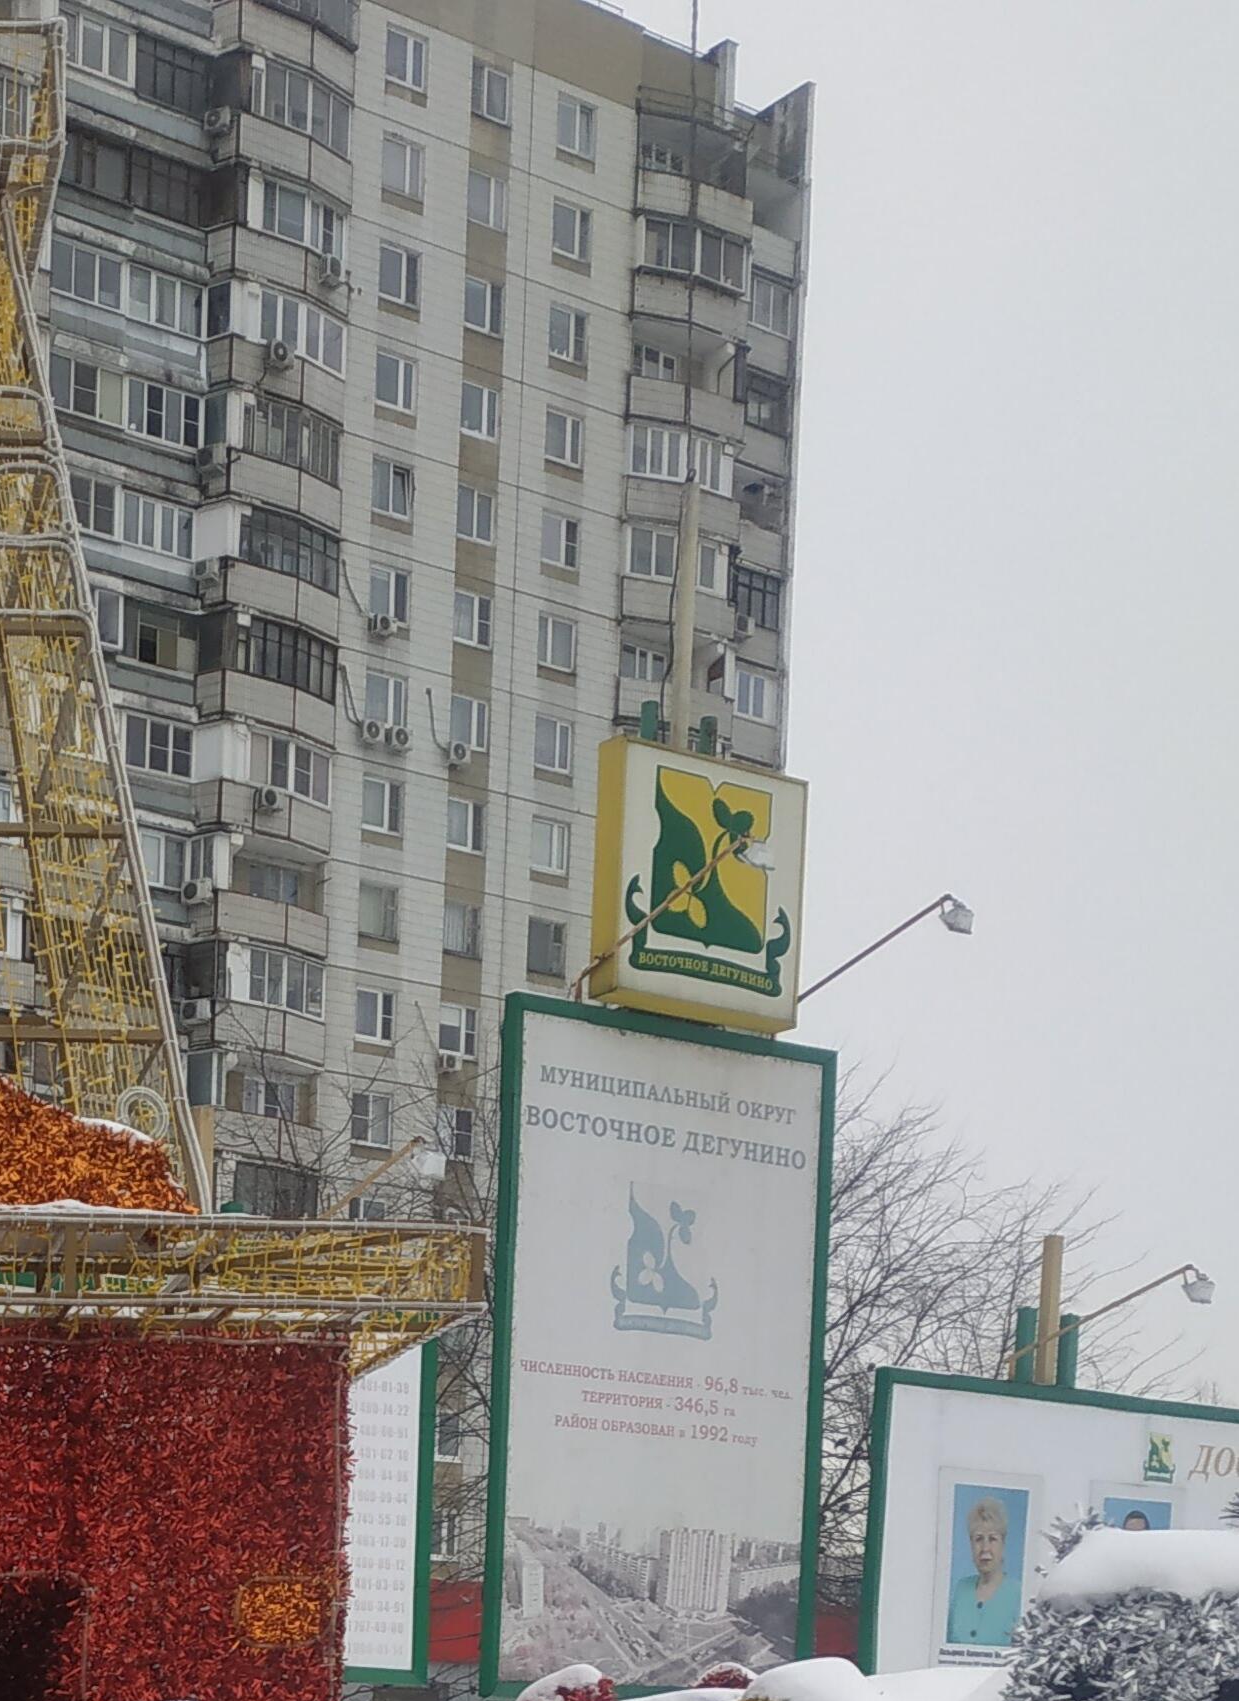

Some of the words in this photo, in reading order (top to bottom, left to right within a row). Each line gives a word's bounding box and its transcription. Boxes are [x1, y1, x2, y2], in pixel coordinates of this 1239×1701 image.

[638, 951, 709, 973] ВОСТОЧНОЕ
[711, 964, 773, 991] ДЕГУНИНО
[540, 1065, 731, 1114] МУНИЦИПАЛЬНЫЙ
[737, 1101, 796, 1125] ОКРУГ
[526, 1105, 676, 1148] ВОСТОЧНОЕ
[682, 1131, 807, 1170] ДЕГУНИНО
[520, 1359, 615, 1380] ЧИСЛЕННОСТЬ
[618, 1369, 694, 1389] НАСЕЛЕНИЯ
[705, 1376, 738, 1395] 96,8
[582, 1390, 663, 1410] ТЕРРИТОРИЯ
[674, 1396, 719, 1416] 346,5
[554, 1413, 598, 1430] РАЙОН
[601, 1419, 675, 1437] ОБРАЗОВАН
[691, 1424, 728, 1442] 1992
[1187, 1444, 1239, 1483] ДО
